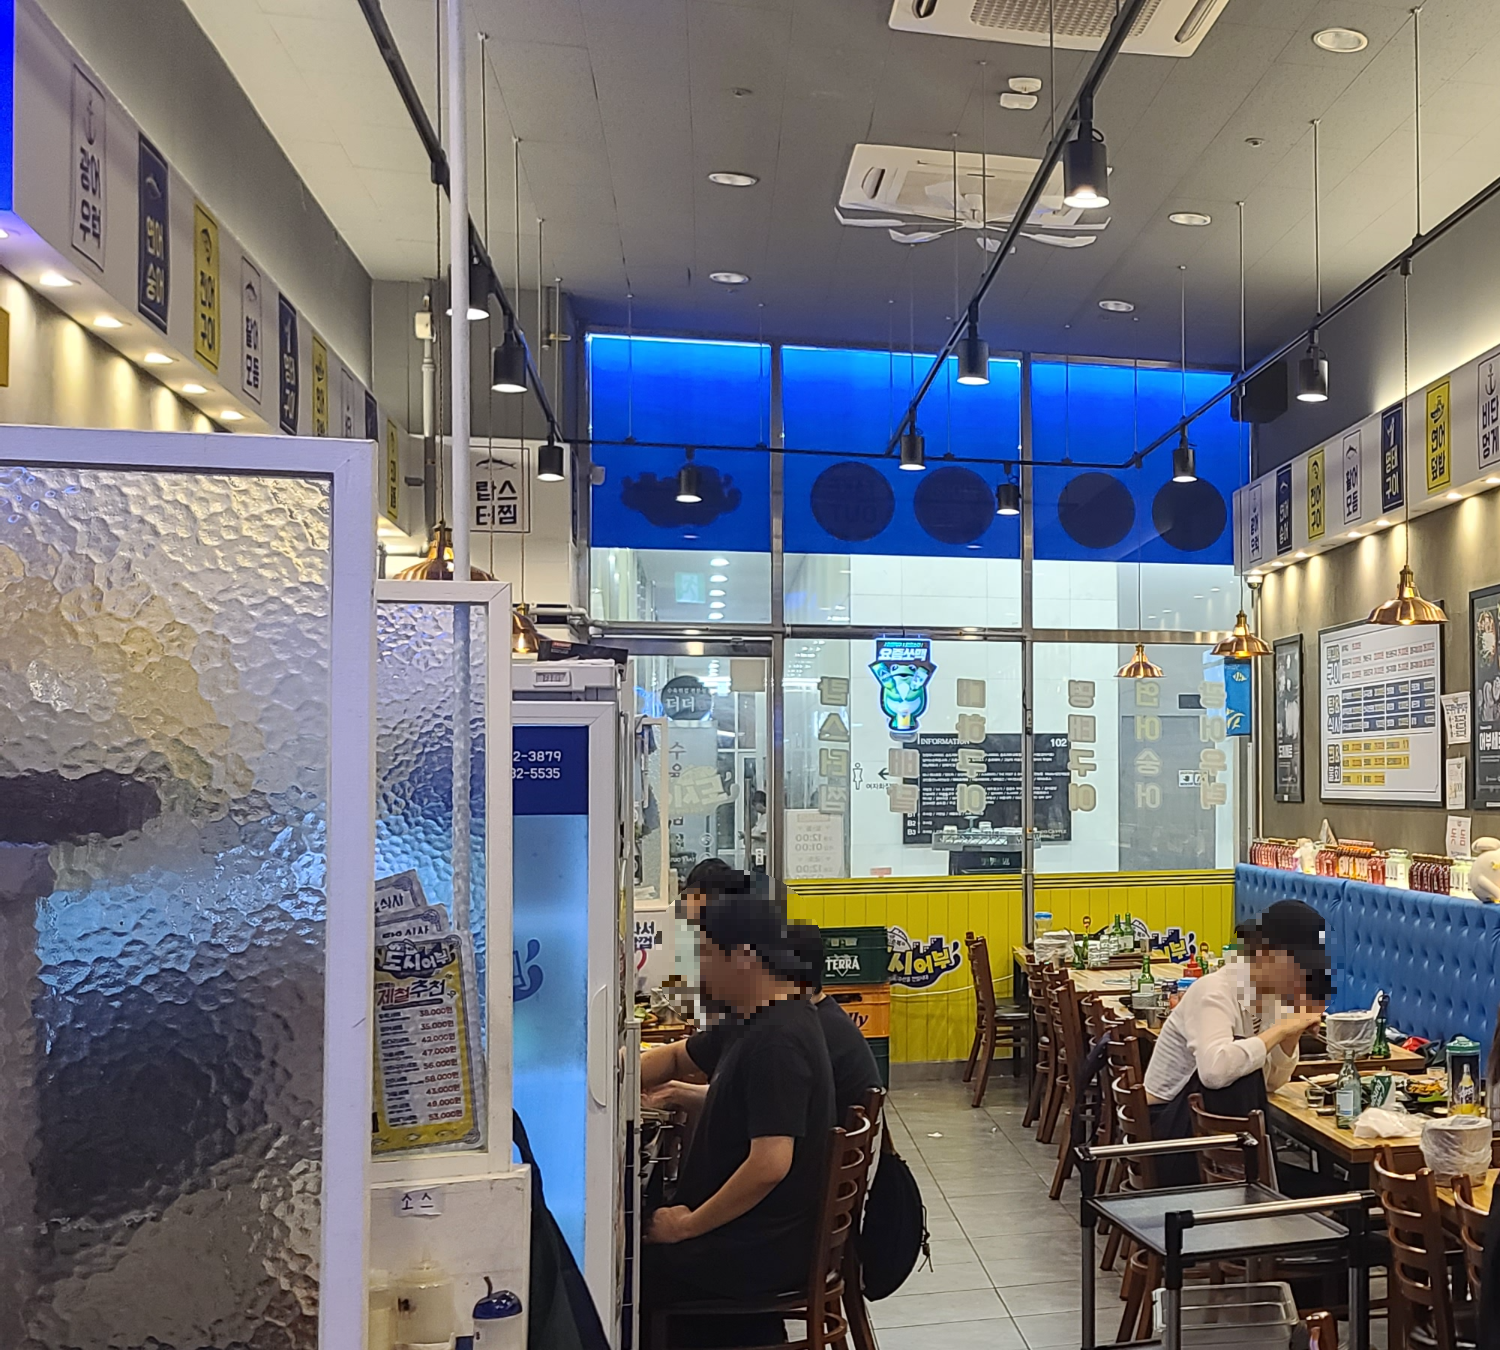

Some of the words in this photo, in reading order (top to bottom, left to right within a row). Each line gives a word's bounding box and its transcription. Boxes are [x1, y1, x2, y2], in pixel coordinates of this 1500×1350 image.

[79, 146, 101, 200] 광어
[79, 198, 101, 249] 우럭
[145, 215, 164, 260] 연어
[145, 262, 164, 306] 숭어
[200, 270, 216, 310] 전어
[200, 312, 216, 352] 구이
[1482, 395, 1499, 430] 비단
[1431, 422, 1446, 453] 연어
[1482, 425, 1499, 459] 멍게
[475, 479, 518, 502] 랍스
[1385, 472, 1400, 500] 구이
[475, 504, 518, 526] 터찜
[1310, 506, 1322, 531] 구이
[665, 696, 697, 714] 더더
[1050, 738, 1068, 748] 102
[382, 945, 451, 972] 도시어부
[825, 958, 861, 971] TERRA
[887, 947, 951, 976] 시어부
[848, 1012, 869, 1029] lly
